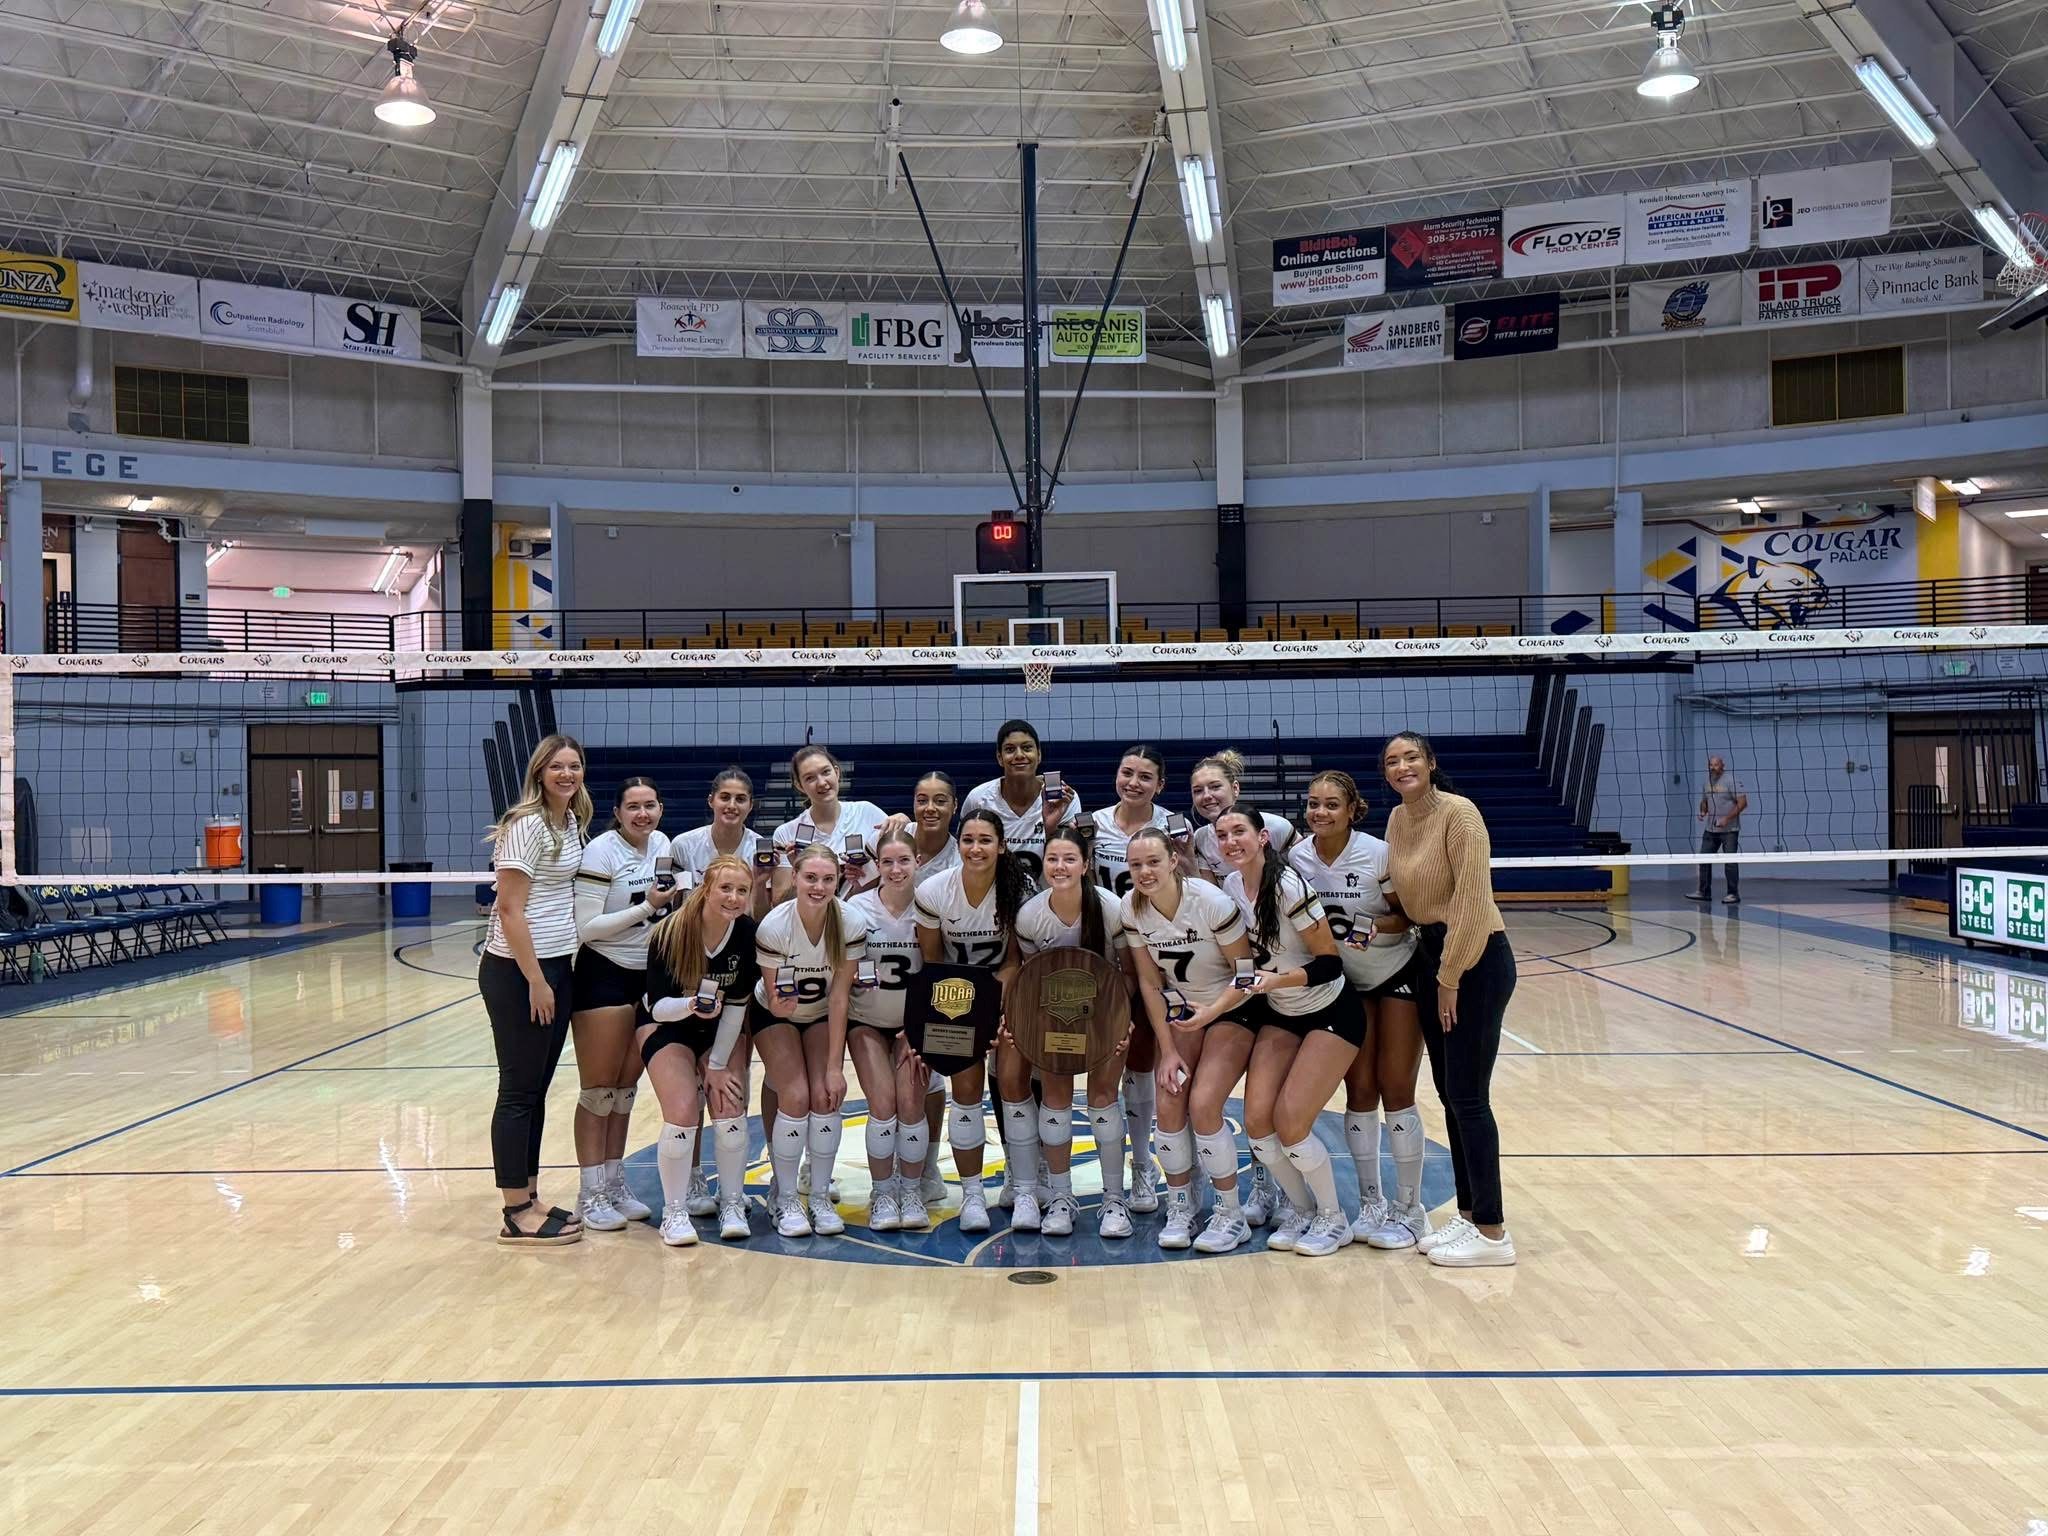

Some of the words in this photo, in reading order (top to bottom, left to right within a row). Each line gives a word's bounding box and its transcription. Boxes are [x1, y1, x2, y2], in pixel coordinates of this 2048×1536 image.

[1702, 189, 1724, 198] Agency
[1648, 211, 1691, 222] AMERICAN
[1695, 208, 1724, 217] FAMILY
[1812, 201, 1859, 213] CONSULTING
[1441, 221, 1465, 229] Security
[1466, 216, 1500, 225] Technicians
[1653, 217, 1718, 228] INSURANCE
[1427, 227, 1495, 244] 308-575-0172
[1532, 226, 1622, 249] FLOYD'S
[1547, 244, 1578, 254] TRUCK
[1581, 240, 1619, 250] CENTER
[1280, 254, 1319, 267] Online
[1322, 245, 1378, 262] Auctions
[1889, 263, 1902, 272] Way
[1904, 260, 1931, 269] Banking
[1933, 256, 1957, 265] Should
[1293, 268, 1323, 279] Buying
[1335, 263, 1363, 274] Selling
[1280, 271, 1378, 291] www.biditbob.com
[1882, 275, 1939, 294] Pinnacle
[1944, 270, 1979, 289] Bank
[98, 285, 175, 308] mackenzie
[1759, 300, 1800, 311] INLAND
[1803, 295, 1841, 308] TRUCK
[700, 303, 719, 312] PPD
[1759, 310, 1789, 320] PARTS
[1801, 305, 1842, 317] SERVICE
[226, 311, 266, 323] Outpatient
[268, 316, 305, 328] Radiology
[343, 302, 400, 347] SH
[1388, 320, 1440, 336] SANDBERG
[874, 318, 944, 348] FBG
[1056, 332, 1088, 343] AUTO
[1347, 344, 1385, 353] HONDA
[1386, 334, 1442, 351] IMPLEMENT
[897, 353, 937, 361] SERVICES
[1764, 527, 1905, 557] COUGAR
[1830, 548, 1889, 564] PALACE
[58, 656, 103, 666] COUGARS
[179, 655, 225, 665] COUGARS
[302, 654, 347, 664] COUGARS
[425, 652, 471, 663] COUGARS
[549, 652, 594, 662] COUGARS
[670, 651, 716, 661] COUGARS
[792, 650, 836, 660] COUGARS
[912, 648, 957, 659] COUGARS
[1032, 647, 1077, 657] COUGARS
[1152, 645, 1197, 656] COUGARS
[1273, 643, 1318, 653] COUGARS
[1395, 640, 1440, 650] COUGARS
[1518, 637, 1565, 648] COUGARS
[1643, 634, 1690, 645] COUGARS
[1768, 632, 1815, 642] COUGARS
[1894, 630, 1939, 641] COUGARS
[1316, 891, 1361, 899] THEASTERN
[1961, 878, 1993, 915] B&C
[2008, 883, 2044, 922] B&C
[1961, 913, 1993, 931] STEEL
[2008, 920, 2044, 938] STEEL
[879, 955, 911, 990] 3
[1159, 950, 1195, 983] 7
[798, 977, 827, 1004] 9
[933, 985, 973, 1002] NJCAA
